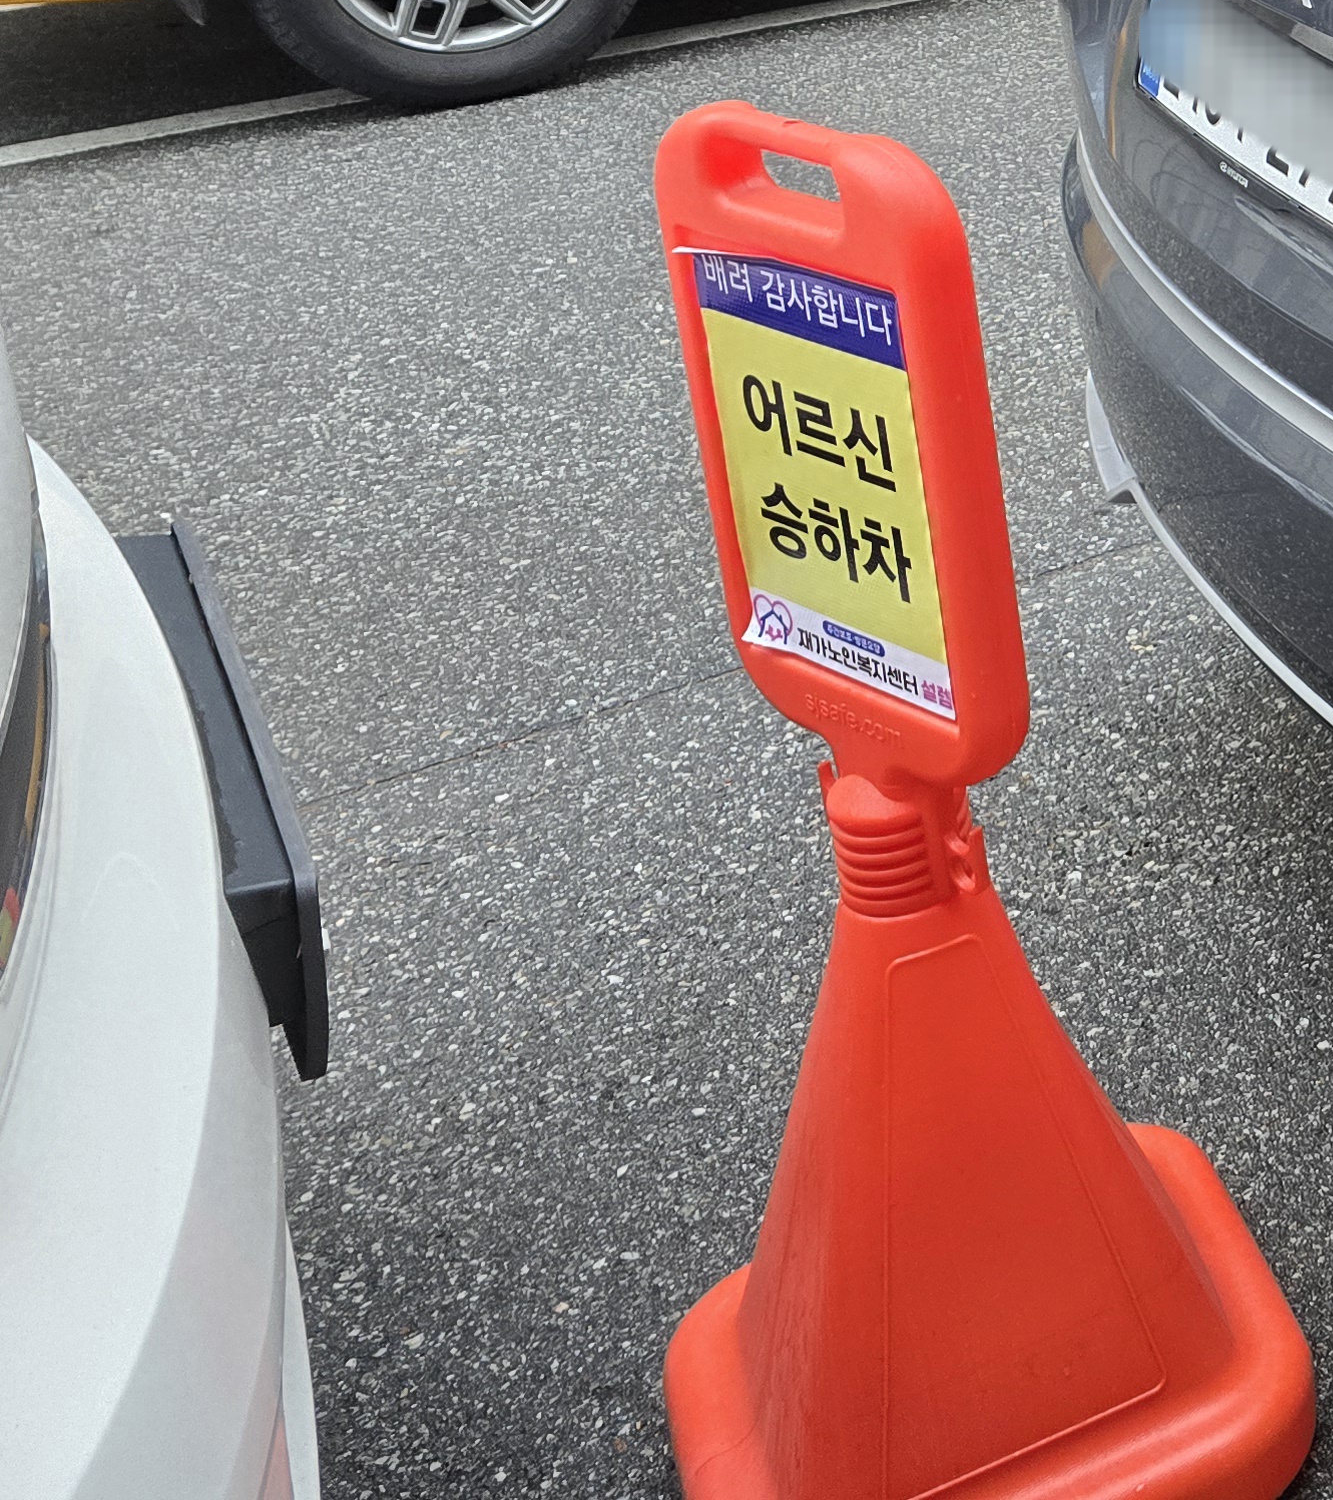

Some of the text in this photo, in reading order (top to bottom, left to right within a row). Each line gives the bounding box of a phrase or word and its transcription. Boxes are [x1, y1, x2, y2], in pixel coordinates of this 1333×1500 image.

[701, 254, 893, 346] 배려 감사합니다
[742, 373, 898, 493] 어르신
[761, 482, 911, 603] 승하차
[797, 627, 953, 711] 재가노인복지센터 설렘
